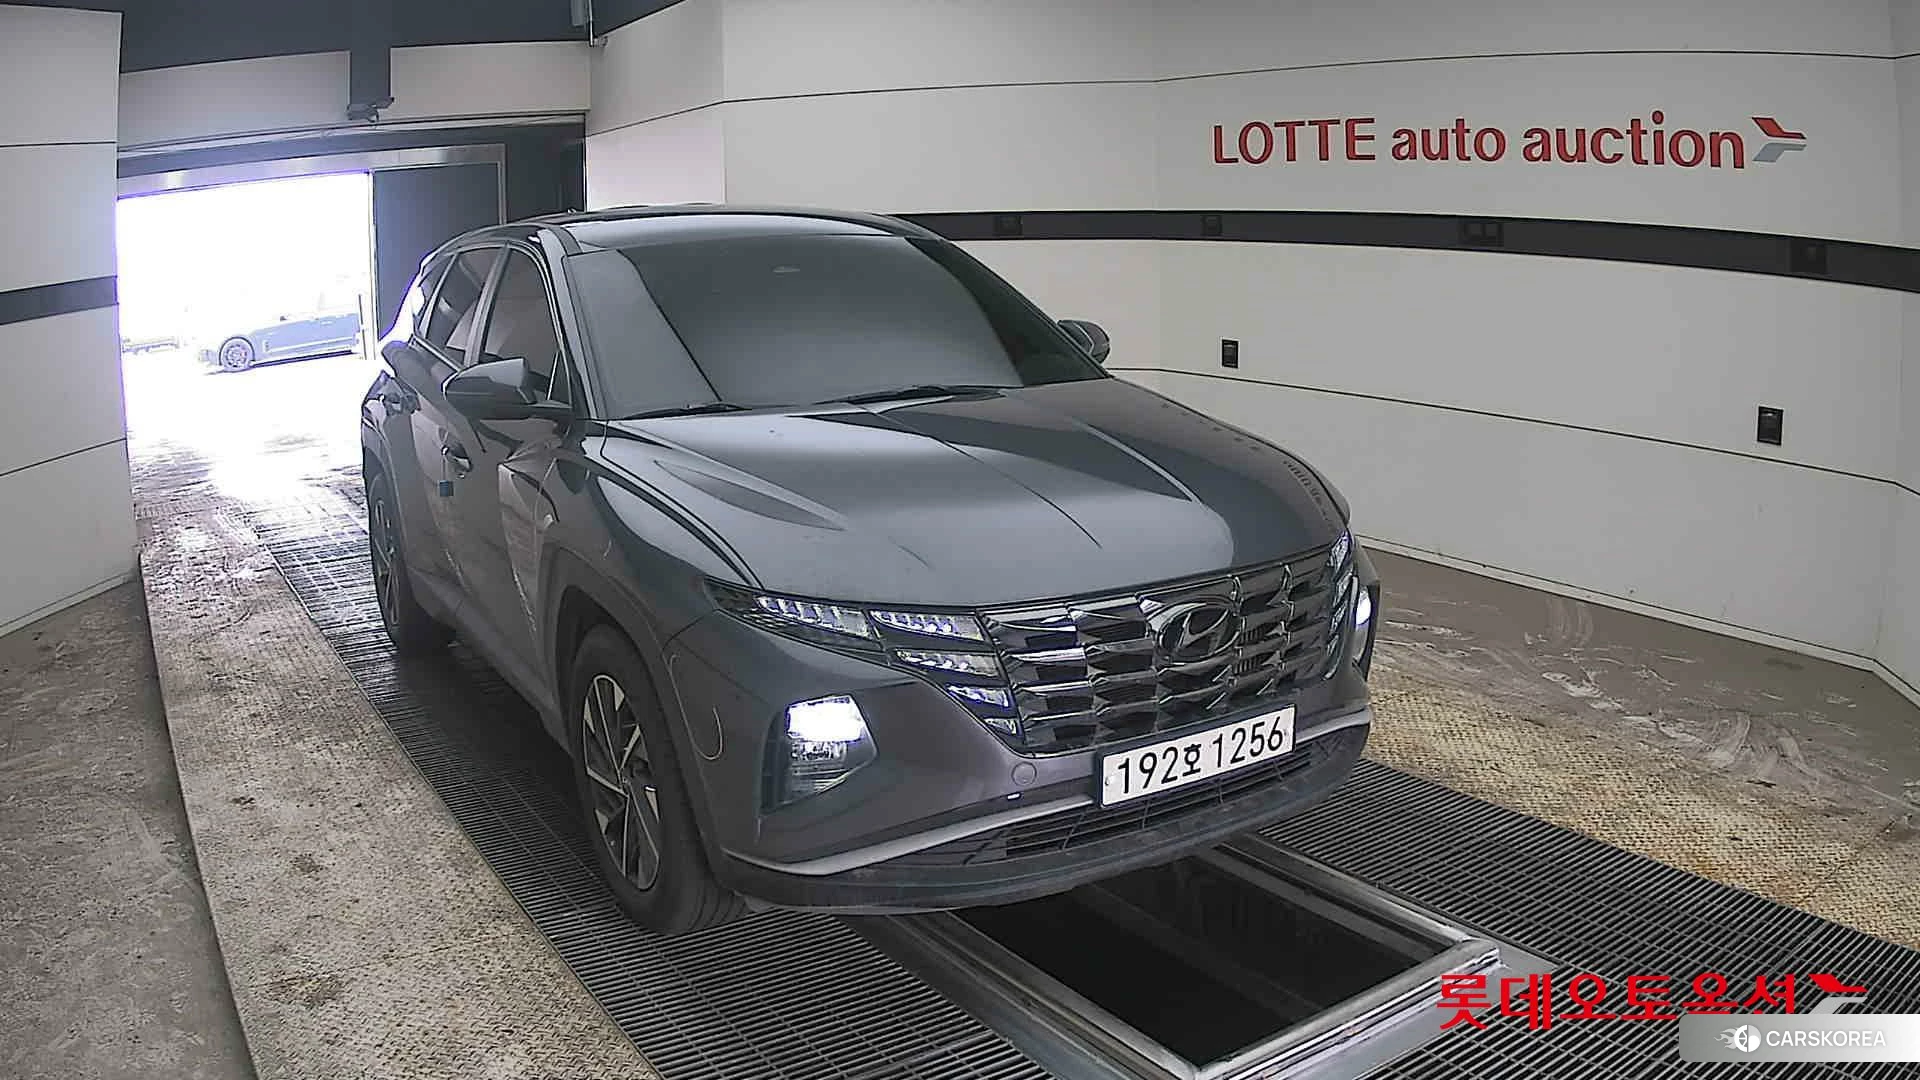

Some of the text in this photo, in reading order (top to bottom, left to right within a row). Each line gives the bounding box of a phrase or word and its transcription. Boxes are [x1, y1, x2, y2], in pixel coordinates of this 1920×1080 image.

[1213, 110, 1744, 169] LOTTE auto auction
[1118, 716, 1284, 794] 192호 1256
